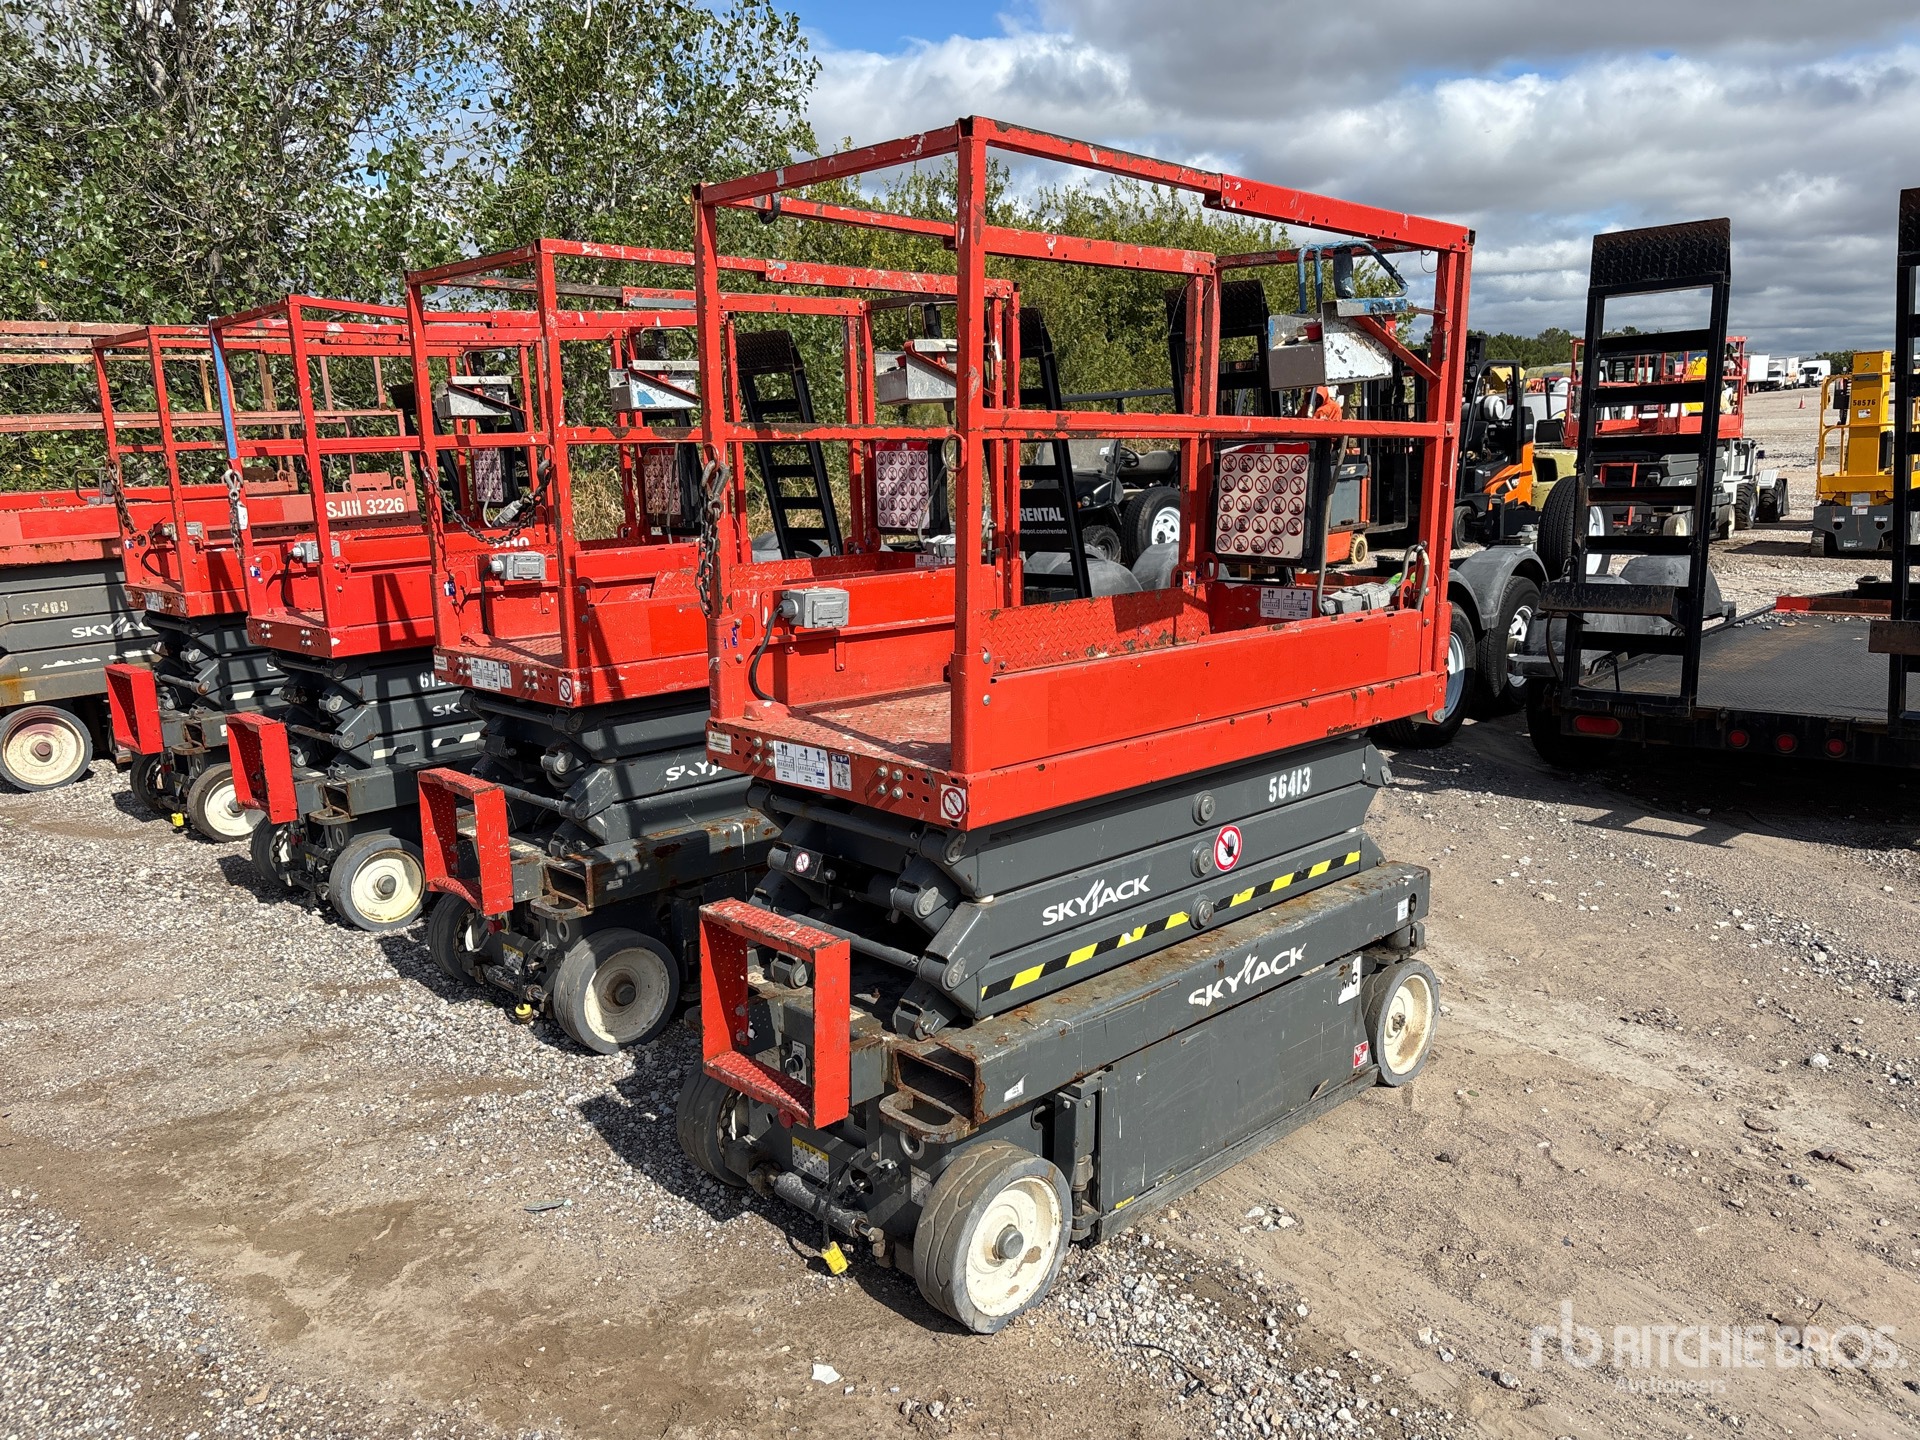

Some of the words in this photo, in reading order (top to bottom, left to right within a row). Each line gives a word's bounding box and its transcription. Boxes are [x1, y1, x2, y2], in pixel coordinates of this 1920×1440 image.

[366, 497, 405, 516] 3226
[1020, 507, 1065, 522] RENTAL
[1268, 766, 1312, 803] 56413
[1042, 874, 1151, 926] SKYJACK
